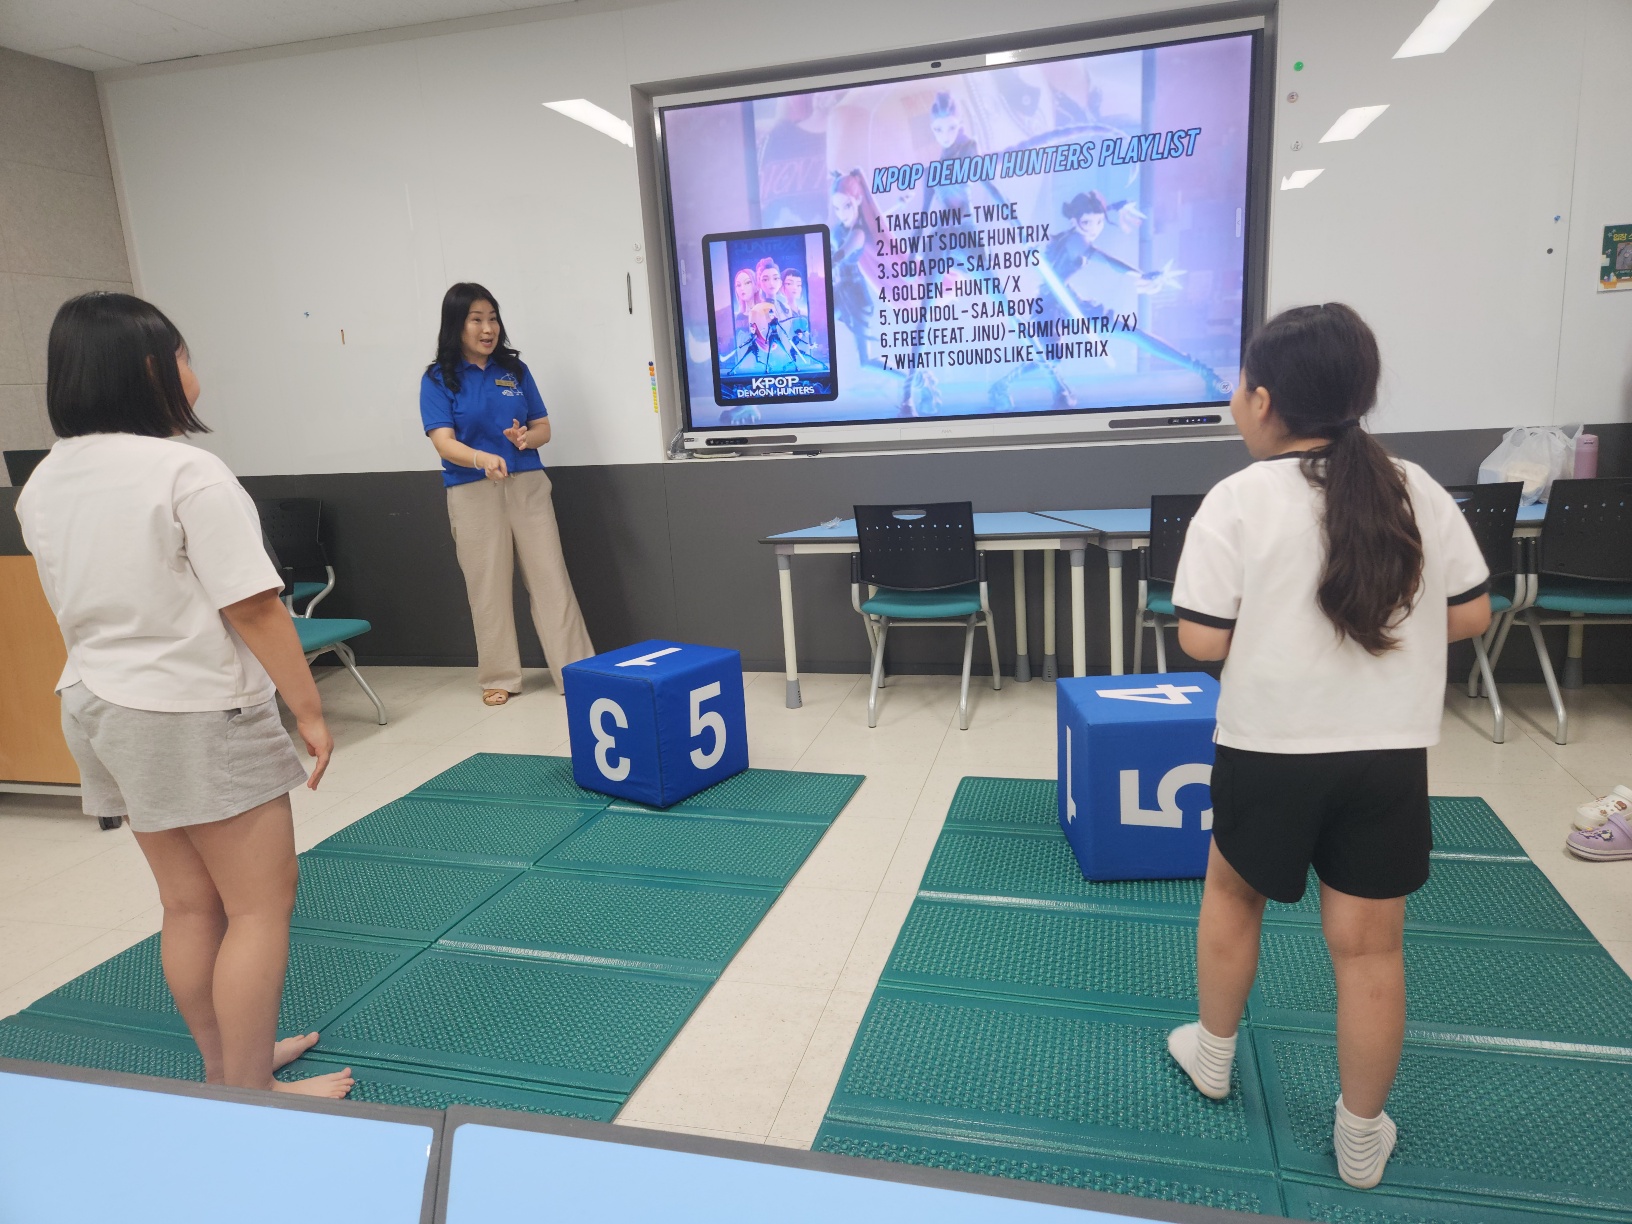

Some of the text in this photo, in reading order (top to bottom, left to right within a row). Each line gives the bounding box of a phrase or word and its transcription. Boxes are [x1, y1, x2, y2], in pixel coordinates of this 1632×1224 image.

[872, 127, 1202, 194] KPOP DEMON HUNTERS PLAYLIST
[875, 215, 885, 233] 1.
[886, 207, 961, 232] TAKEDOWN
[974, 202, 1018, 224] TWICE
[876, 223, 1050, 257] 2. HOW IT'S DONE HUNTRIX
[877, 263, 889, 279] 3.
[891, 259, 926, 278] SODA
[928, 257, 954, 276] POP
[966, 253, 1001, 272] SAJA
[1003, 249, 1040, 269] BOYS
[878, 286, 891, 303] 4.
[892, 282, 943, 302] GOLDEN
[879, 309, 891, 326] 5.
[892, 306, 927, 325] YOUR
[929, 304, 959, 322] IDOL
[971, 300, 1005, 319] SAJA
[1007, 297, 1044, 316] BOYS
[880, 332, 892, 348] 6.
[893, 329, 925, 347] FREE
[927, 326, 969, 346] (FEAT.
[971, 322, 1005, 343] JINU)
[1018, 319, 1053, 339] RUMI
[881, 354, 893, 370] 7.
[894, 351, 931, 370] WHAT
[933, 350, 945, 367] IT
[947, 347, 1002, 366] SOUNDS
[1004, 345, 1034, 363] LIKE
[1046, 340, 1109, 360] HUNTRIX
[737, 386, 815, 398] DEMON HUNTERS
[614, 647, 683, 667] 1
[1095, 684, 1204, 705] 4
[589, 697, 631, 782] 3
[689, 680, 727, 770] 5
[1119, 763, 1214, 831] 5
